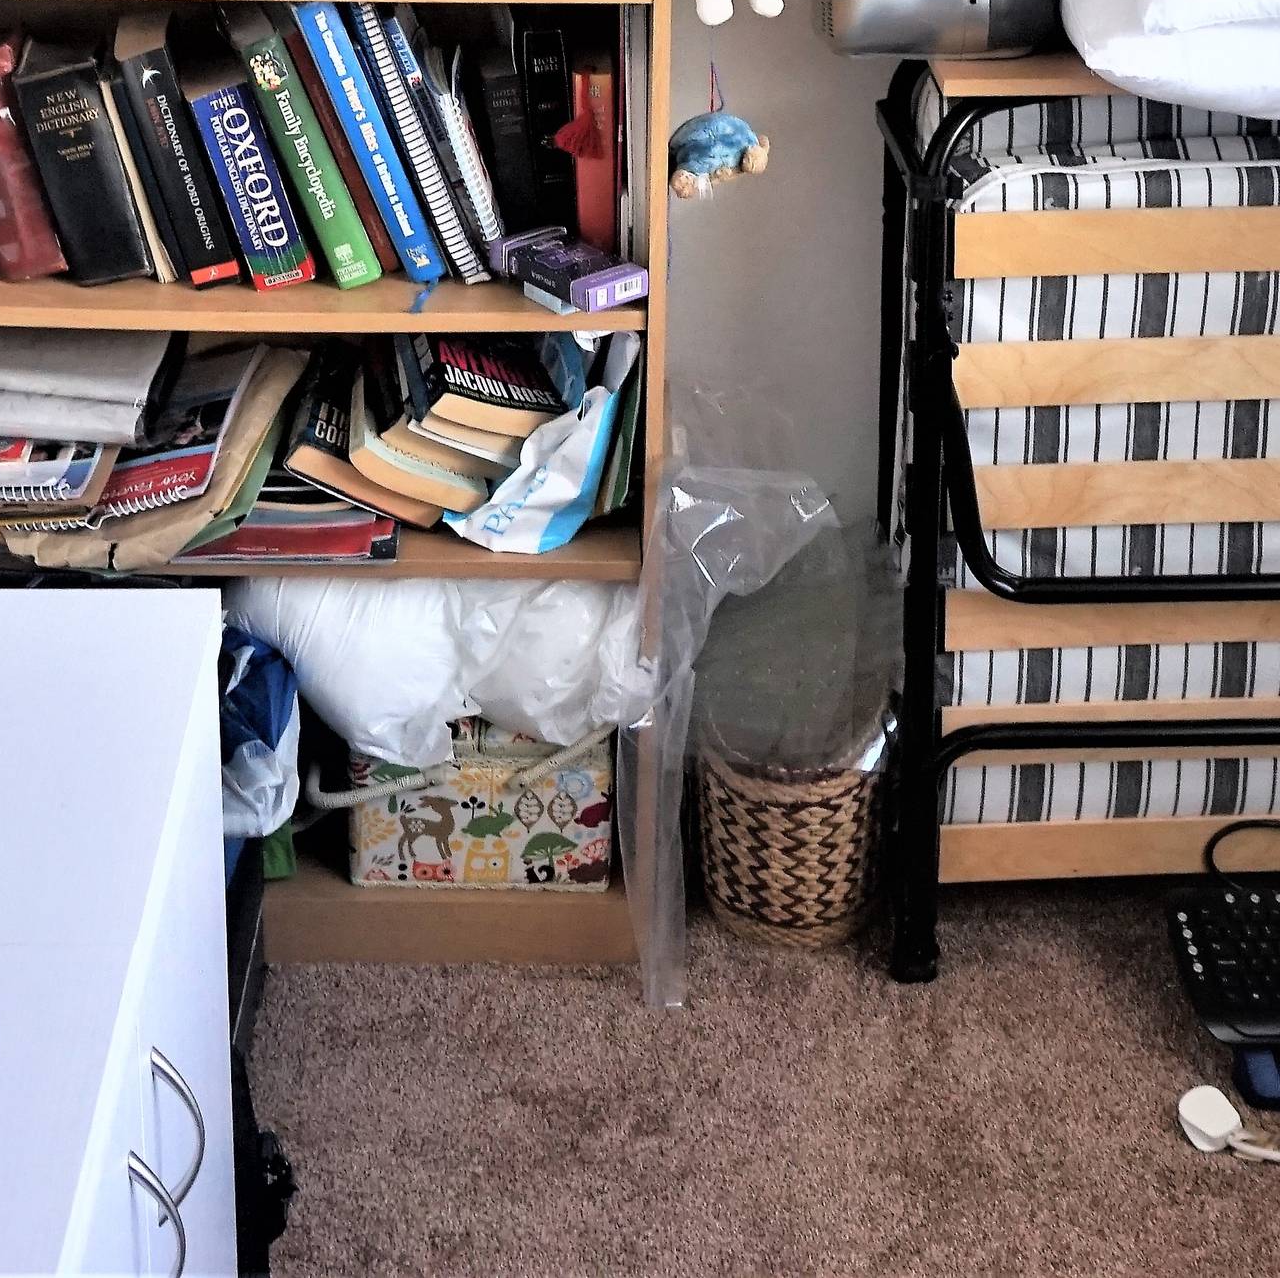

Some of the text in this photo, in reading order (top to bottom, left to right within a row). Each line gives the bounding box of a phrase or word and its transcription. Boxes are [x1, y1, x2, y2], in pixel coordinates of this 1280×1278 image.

[314, 11, 326, 29] The
[319, 29, 347, 77] Complete
[40, 97, 90, 119] ENGLISH
[46, 88, 77, 105] NEW
[209, 93, 236, 110] THE
[340, 74, 367, 122] Driver's
[35, 107, 99, 133] DICTIONARY
[359, 122, 379, 153] Atlas
[156, 94, 215, 251] DICTIONARY OF WORD ORIGINS
[274, 88, 335, 221] Family Encyclopedia
[371, 152, 381, 164] of
[210, 116, 264, 252] POPULAR ENGLISH DICTIONARY
[222, 106, 289, 248] OXFORD
[444, 363, 509, 399] JACQUI
[508, 383, 556, 405] ROSE
